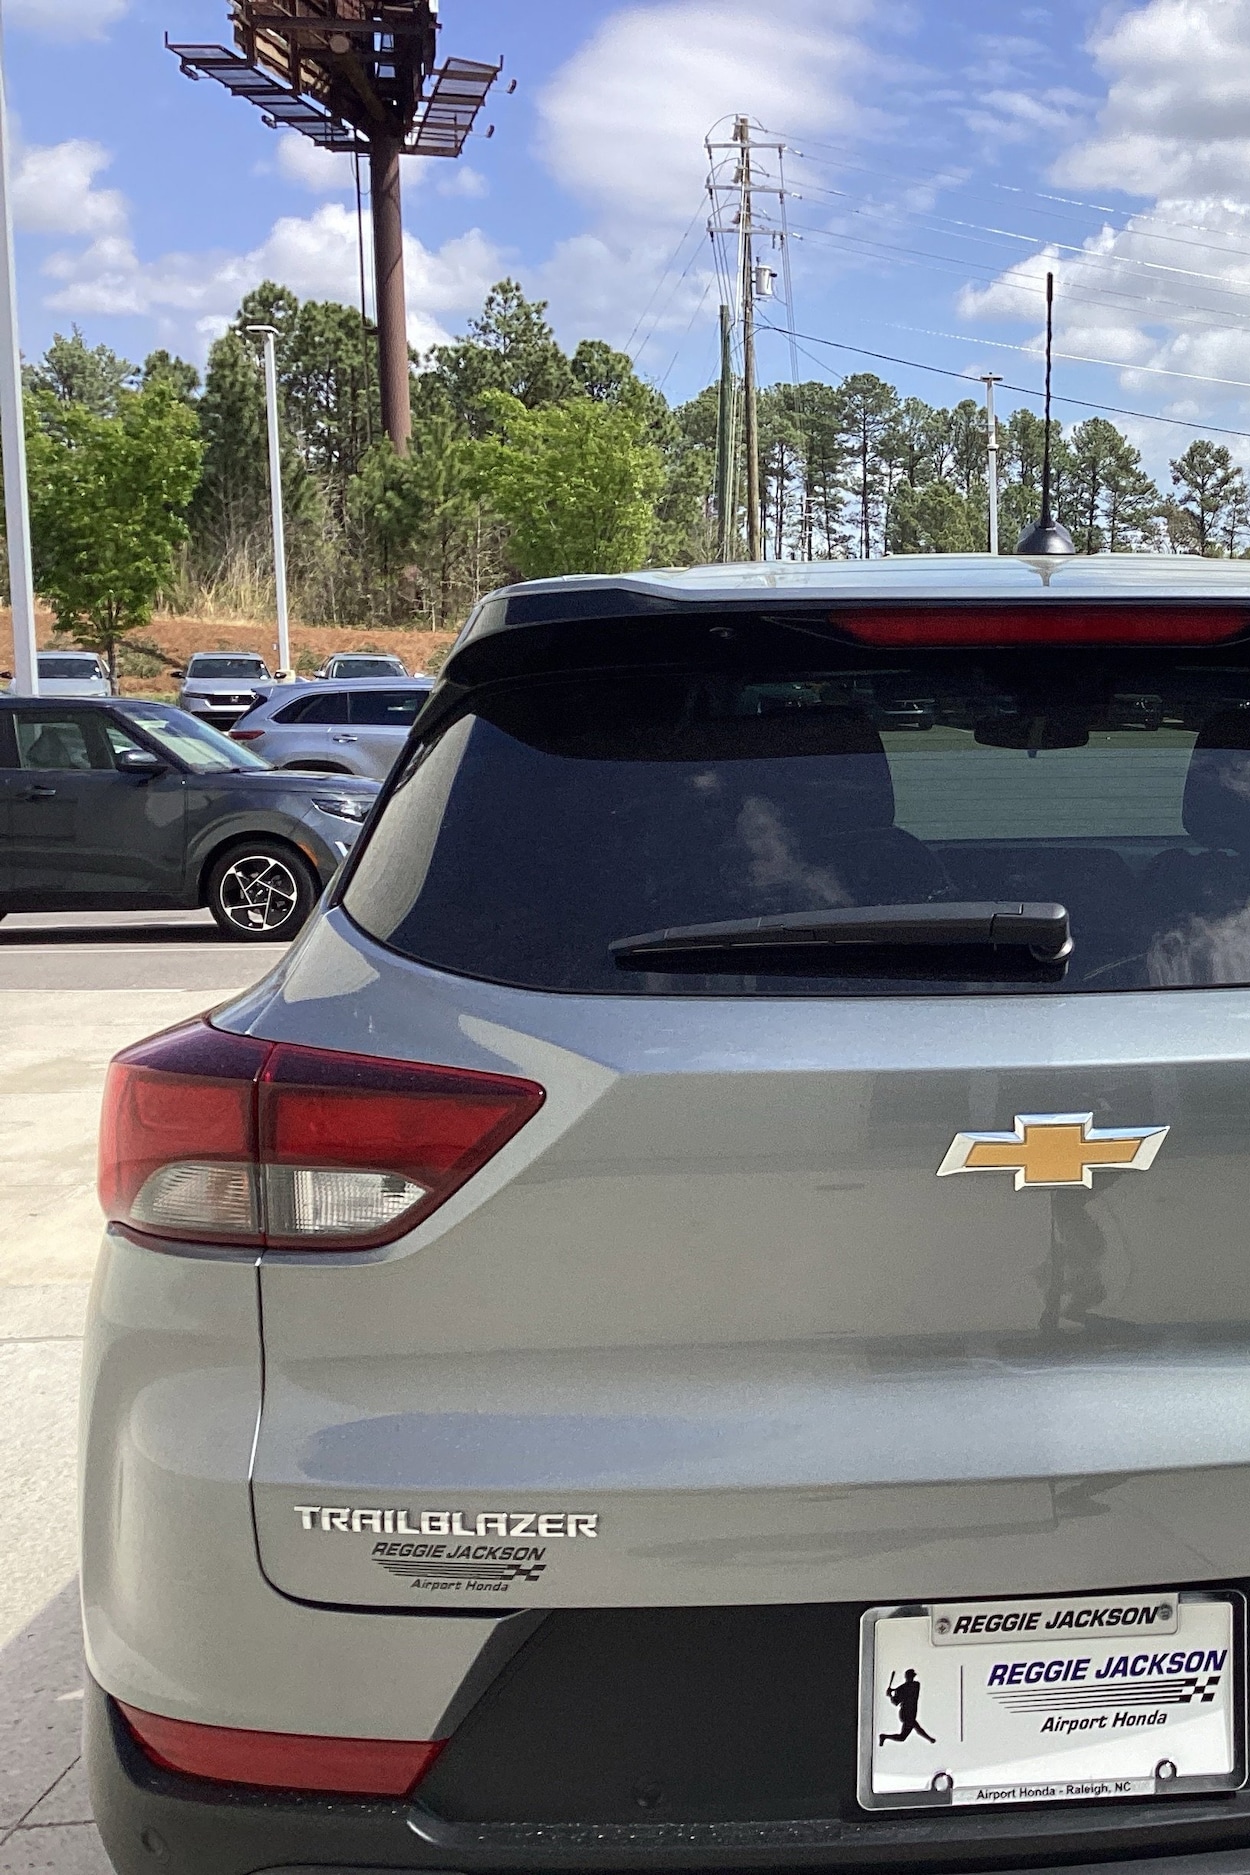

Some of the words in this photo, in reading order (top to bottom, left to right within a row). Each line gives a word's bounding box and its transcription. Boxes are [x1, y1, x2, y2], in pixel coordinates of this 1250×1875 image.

[294, 1505, 598, 1538] TRAILBLAZER
[371, 1542, 444, 1558] REGGIE
[446, 1545, 546, 1561] JACKSON
[410, 1579, 462, 1592] Airport
[465, 1579, 509, 1592] Honda
[953, 1612, 1042, 1635] REGGIE
[1045, 1605, 1160, 1630] JACKSON
[987, 1658, 1091, 1687] REGGIE
[1094, 1649, 1228, 1679] JACKSON
[1040, 1714, 1108, 1734] Airport
[1112, 1710, 1168, 1728] Honda
[976, 1788, 1017, 1802] Airport
[1019, 1786, 1056, 1798] Honda
[1067, 1783, 1113, 1798] Raleigh,
[1115, 1781, 1131, 1792] NC
